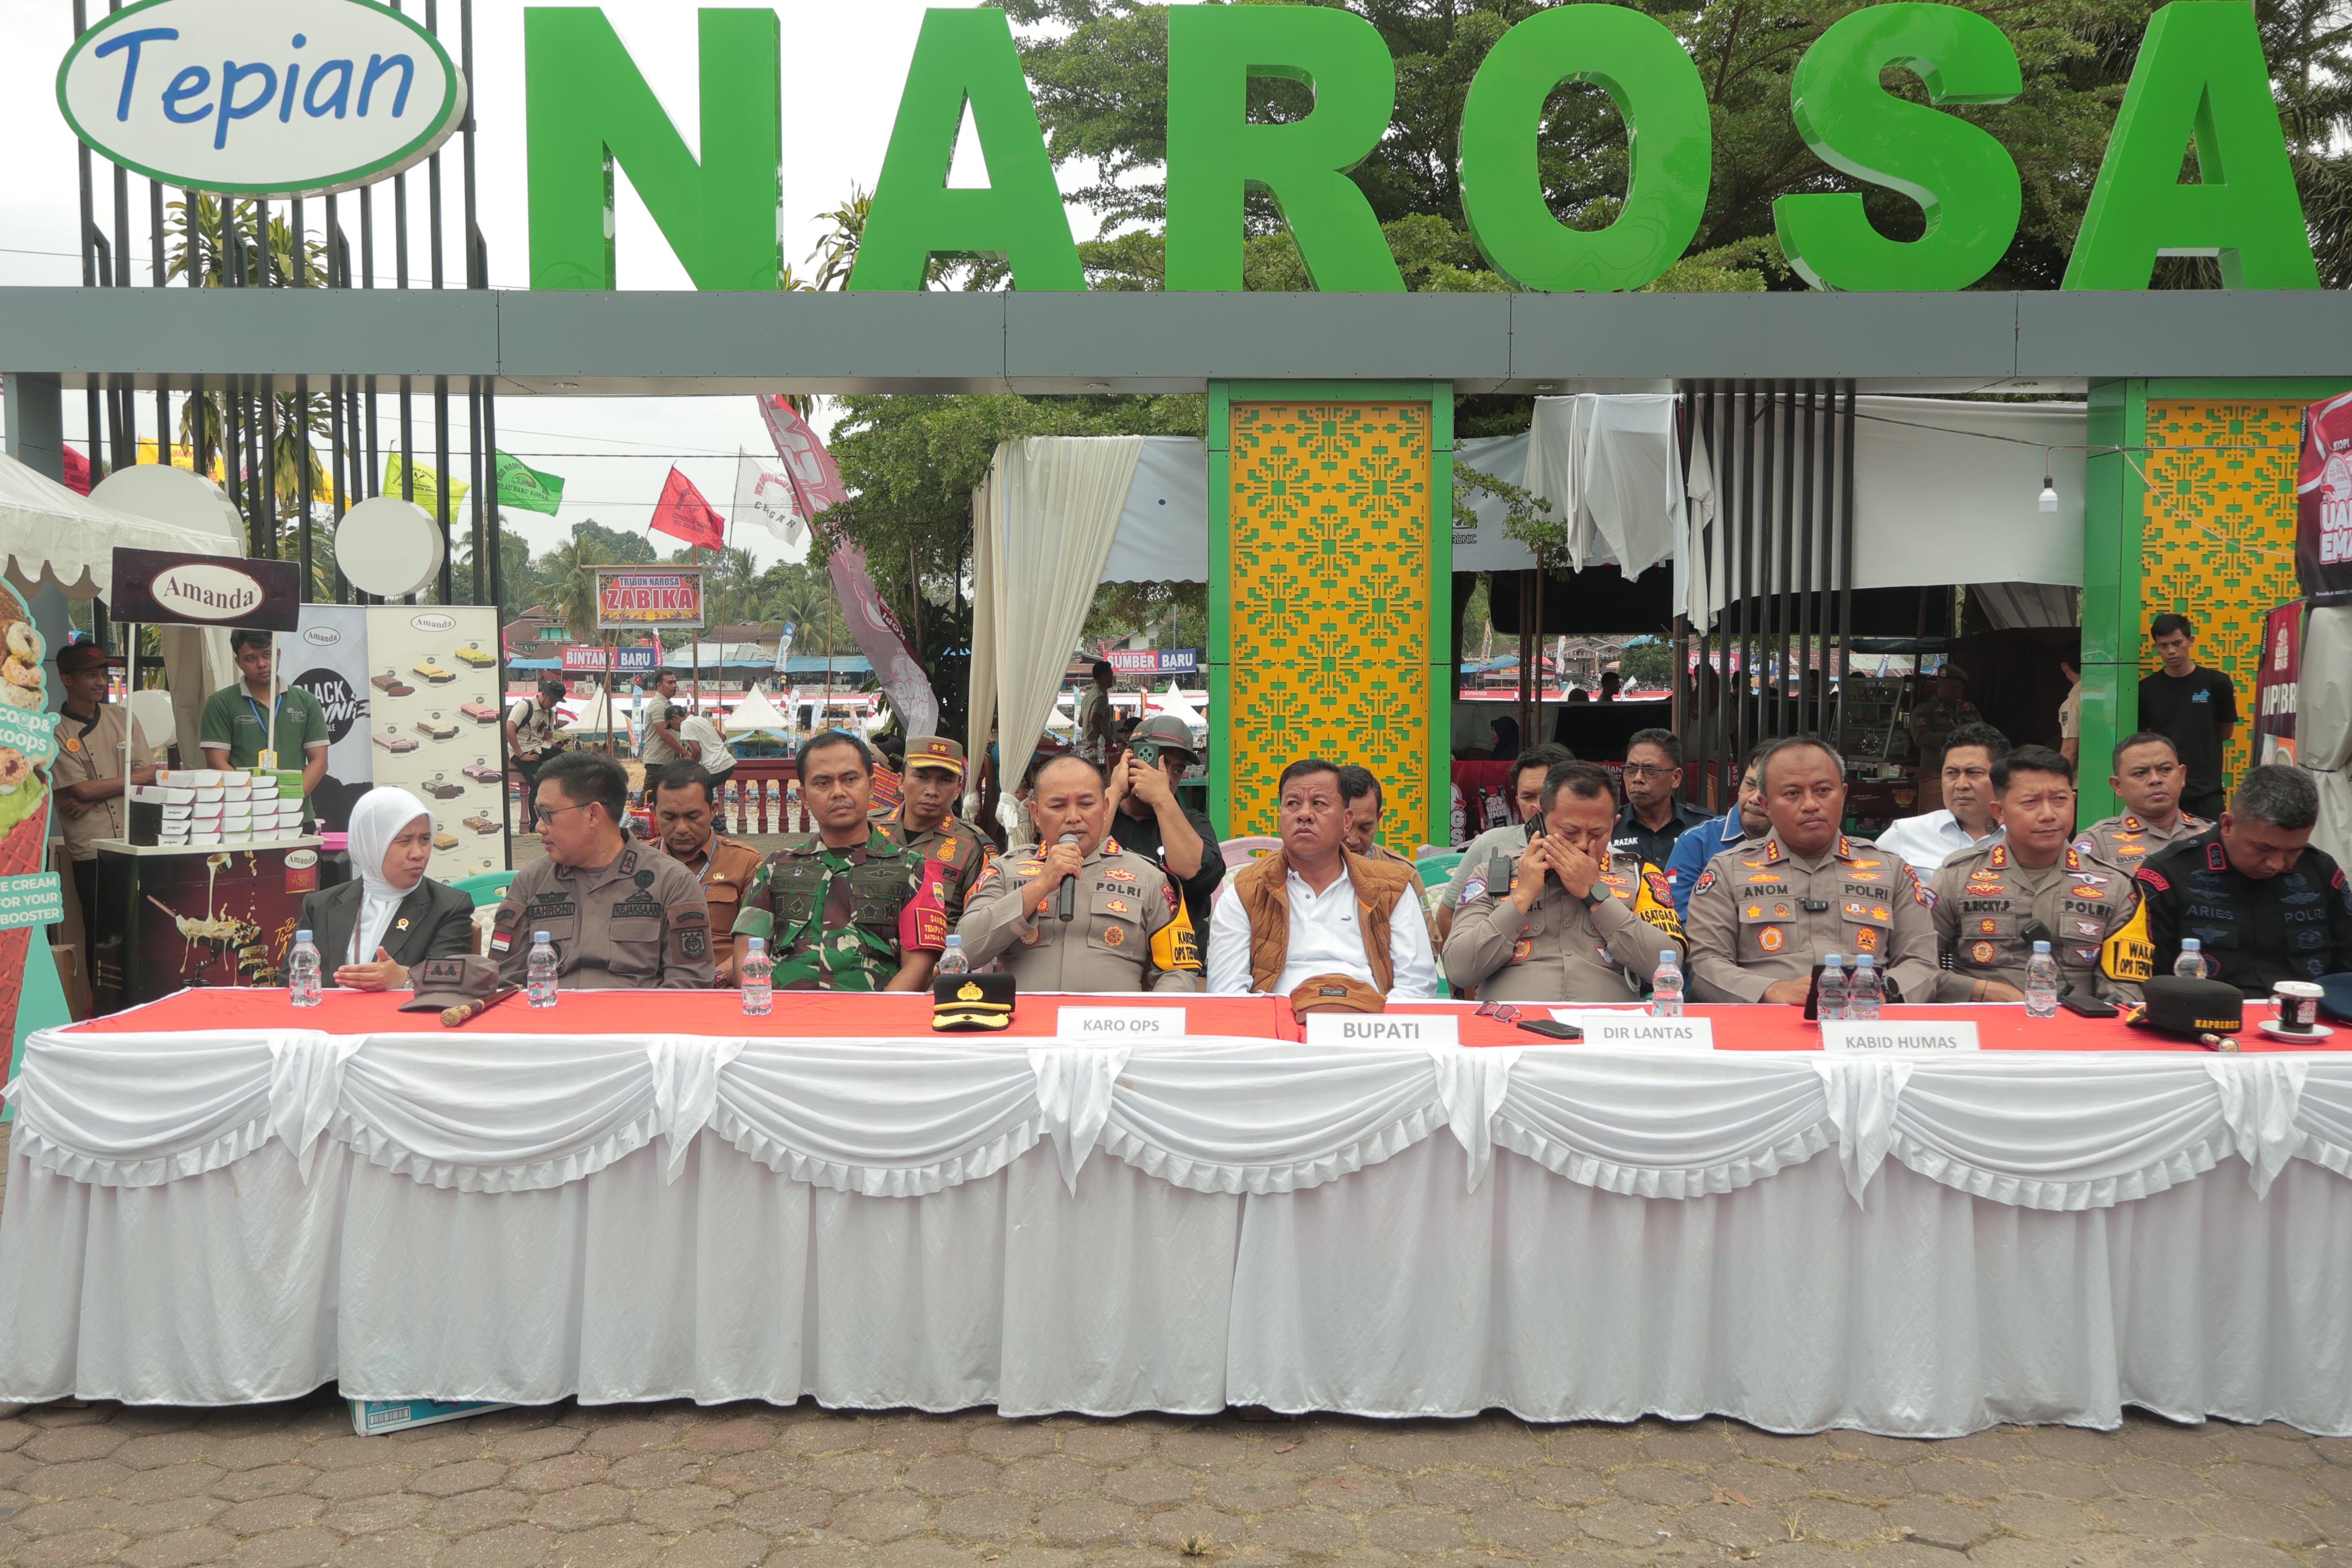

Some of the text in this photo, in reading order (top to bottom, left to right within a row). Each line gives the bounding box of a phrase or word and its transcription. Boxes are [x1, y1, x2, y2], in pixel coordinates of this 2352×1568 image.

[94, 28, 414, 150] Tepian
[525, 0, 2320, 292] NAROSA
[2333, 438, 2350, 451] KOPI
[620, 577, 680, 586] TRIBUN NAROSA
[163, 575, 254, 609] Amanda
[607, 589, 694, 610] ZABIKA
[416, 618, 452, 629] Amanda
[307, 632, 337, 642] Amanda
[621, 652, 650, 667] BARU
[1107, 653, 1193, 668] SUMBER BARU
[1486, 803, 1507, 812] UANG
[1488, 809, 1507, 819] EMAS
[288, 855, 315, 865] Amanda
[942, 868, 957, 877] PP
[12, 877, 57, 891] CREAM
[858, 883, 882, 894] TNI
[1096, 882, 1141, 898] POLRI
[1744, 885, 1788, 898] ANOM
[1844, 884, 1888, 900] POLRI
[0, 893, 58, 908] OR YOUR
[530, 904, 574, 917] BAHRONI
[615, 904, 659, 914] KEJAKSAAN
[2064, 900, 2109, 917] POLRI
[2186, 904, 2234, 920] ARIES
[0, 908, 59, 925] BOOSTER
[2284, 907, 2326, 924] POLRI
[924, 924, 944, 935] TEMPAT
[1083, 1020, 1160, 1032] KARO OPS
[1343, 1022, 1420, 1039] BUPATI
[1603, 1027, 1693, 1039] DIR LANTAS
[1846, 1036, 1957, 1049] KABID HUMAS
